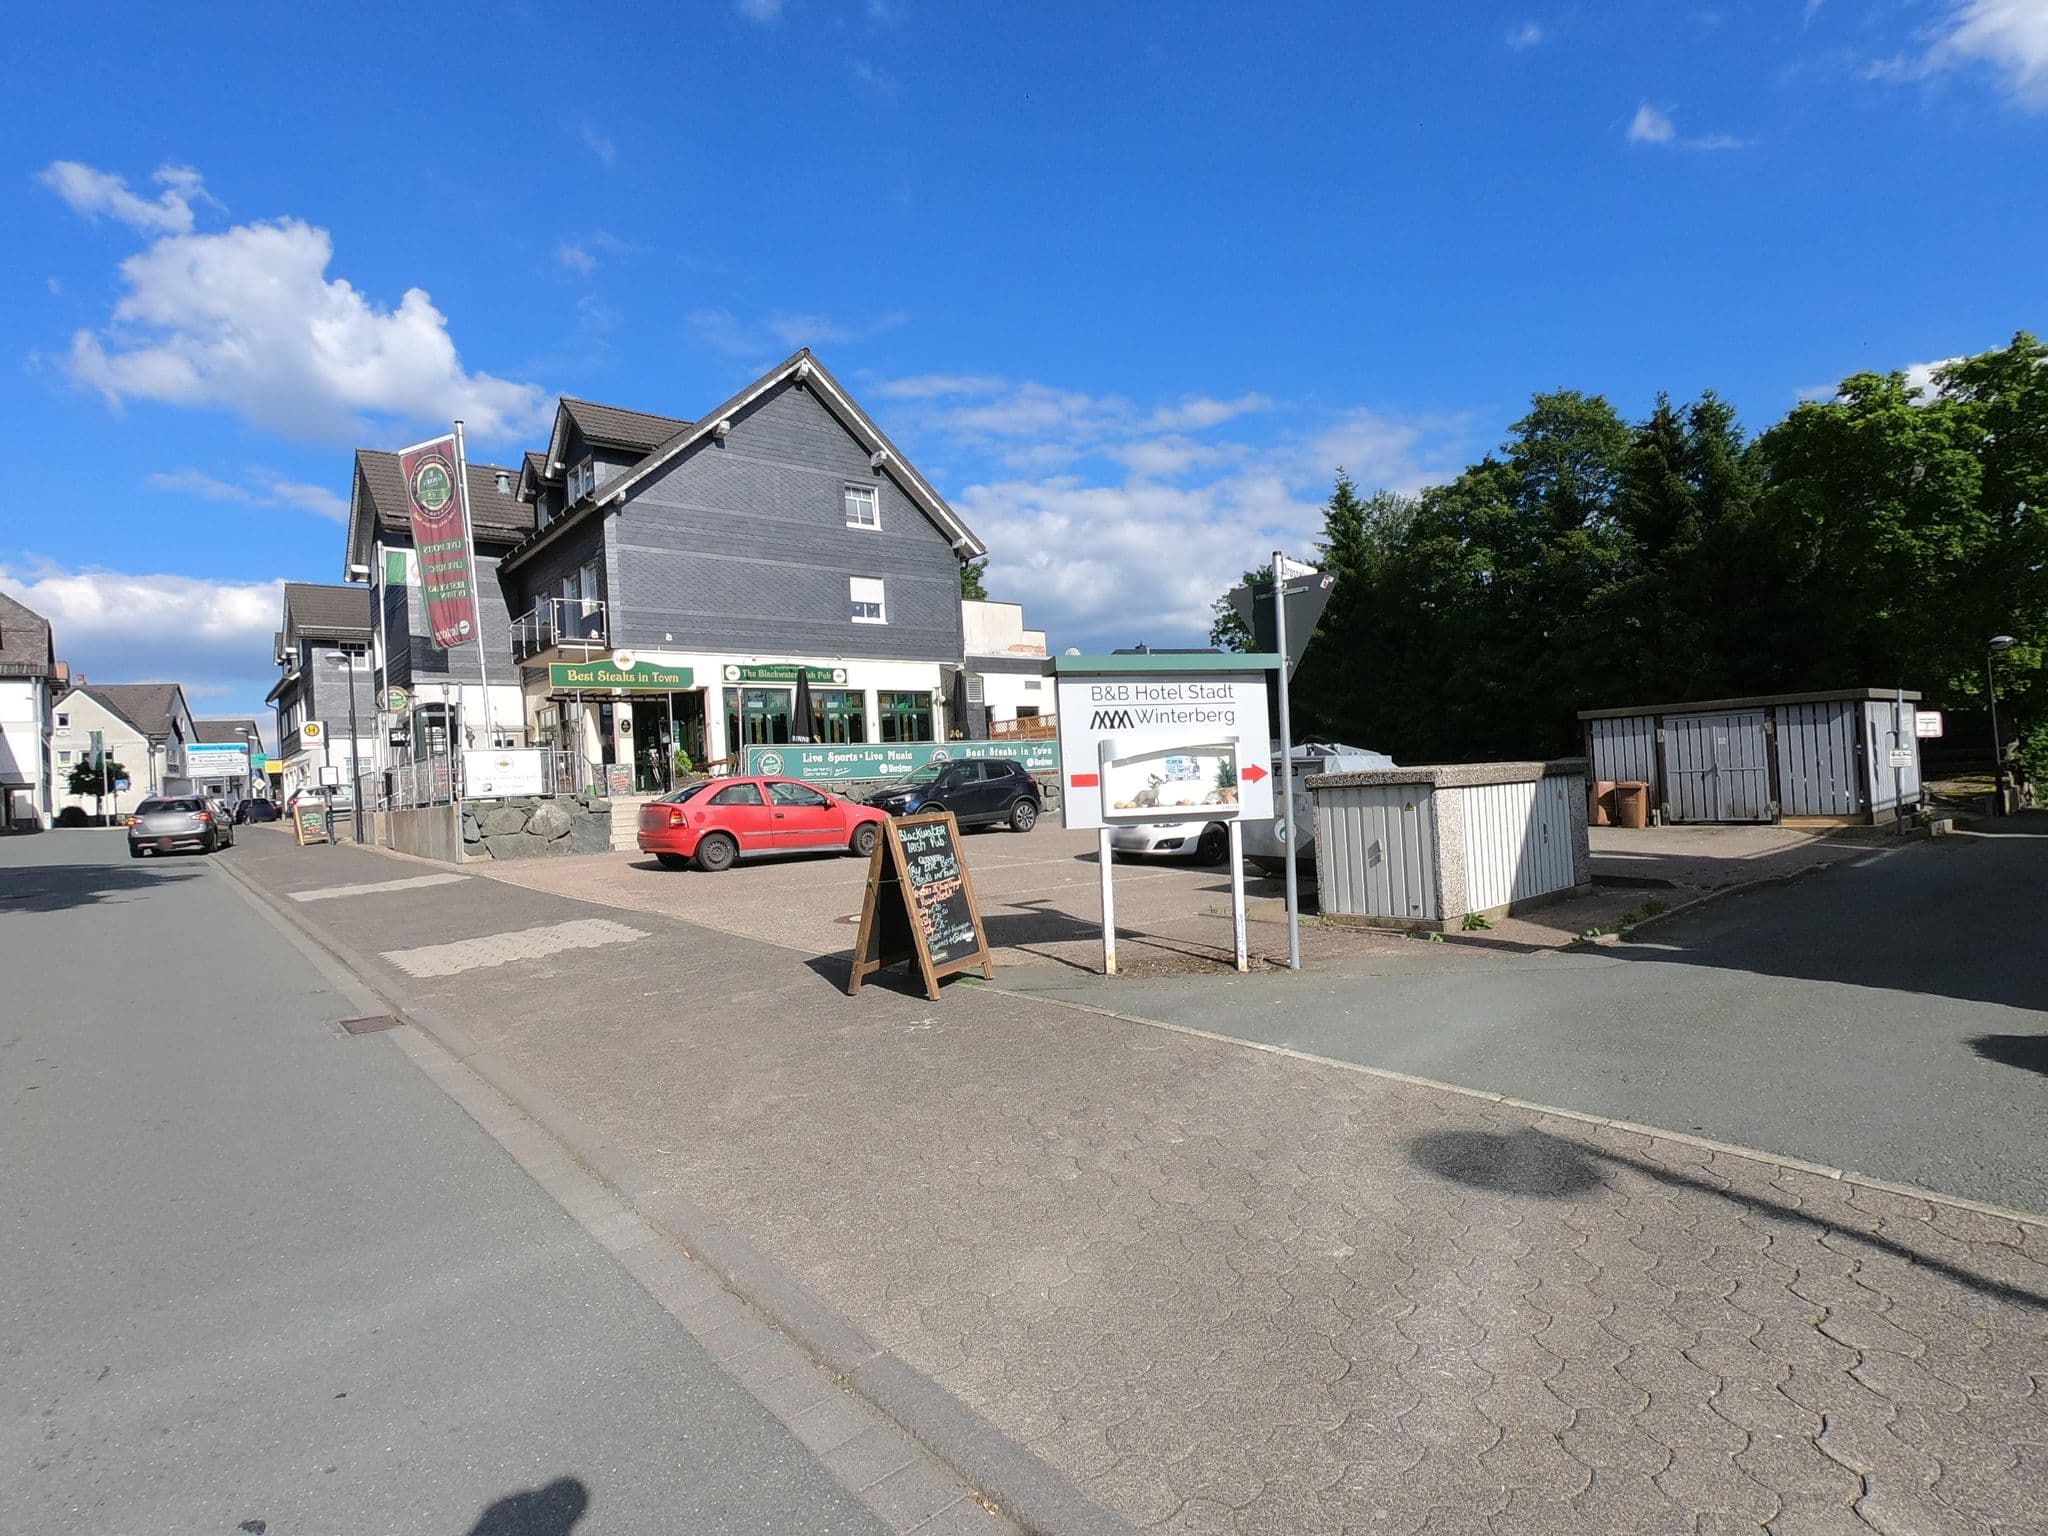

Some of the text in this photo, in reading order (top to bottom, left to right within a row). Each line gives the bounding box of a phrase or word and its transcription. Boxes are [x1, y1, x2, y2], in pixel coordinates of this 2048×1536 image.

[567, 669, 679, 684] Best Steaks in Town
[742, 669, 757, 679] The
[817, 671, 832, 681] Pub
[1091, 683, 1235, 702] B&B Hotel Stadt
[1135, 707, 1235, 726] Winterberg
[802, 750, 914, 765] Live Sports Live Music
[965, 748, 985, 758] Best
[1020, 747, 1029, 756] in
[1032, 746, 1053, 756] Town
